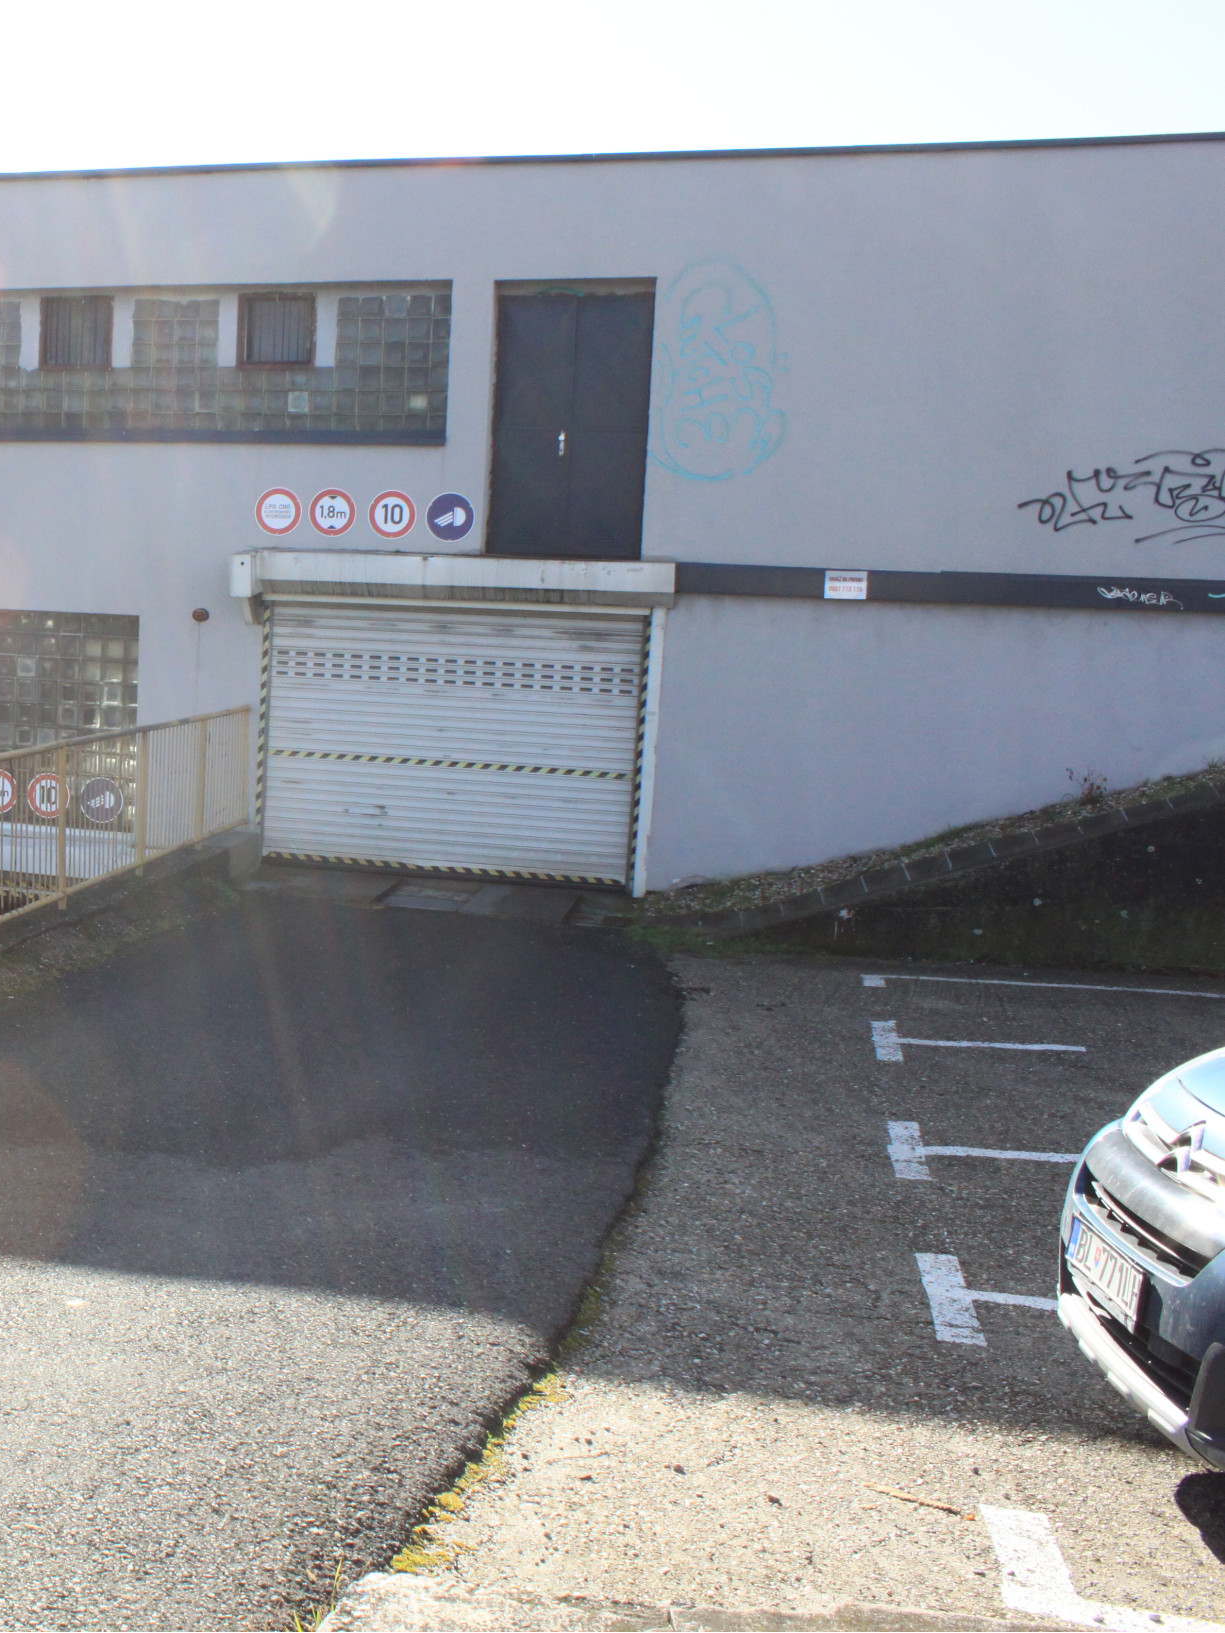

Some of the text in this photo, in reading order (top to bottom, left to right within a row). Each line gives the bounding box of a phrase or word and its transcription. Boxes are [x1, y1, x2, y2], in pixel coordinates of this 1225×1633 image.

[319, 505, 347, 520] 1,8m
[381, 503, 404, 525] 10
[40, 785, 57, 805] 10
